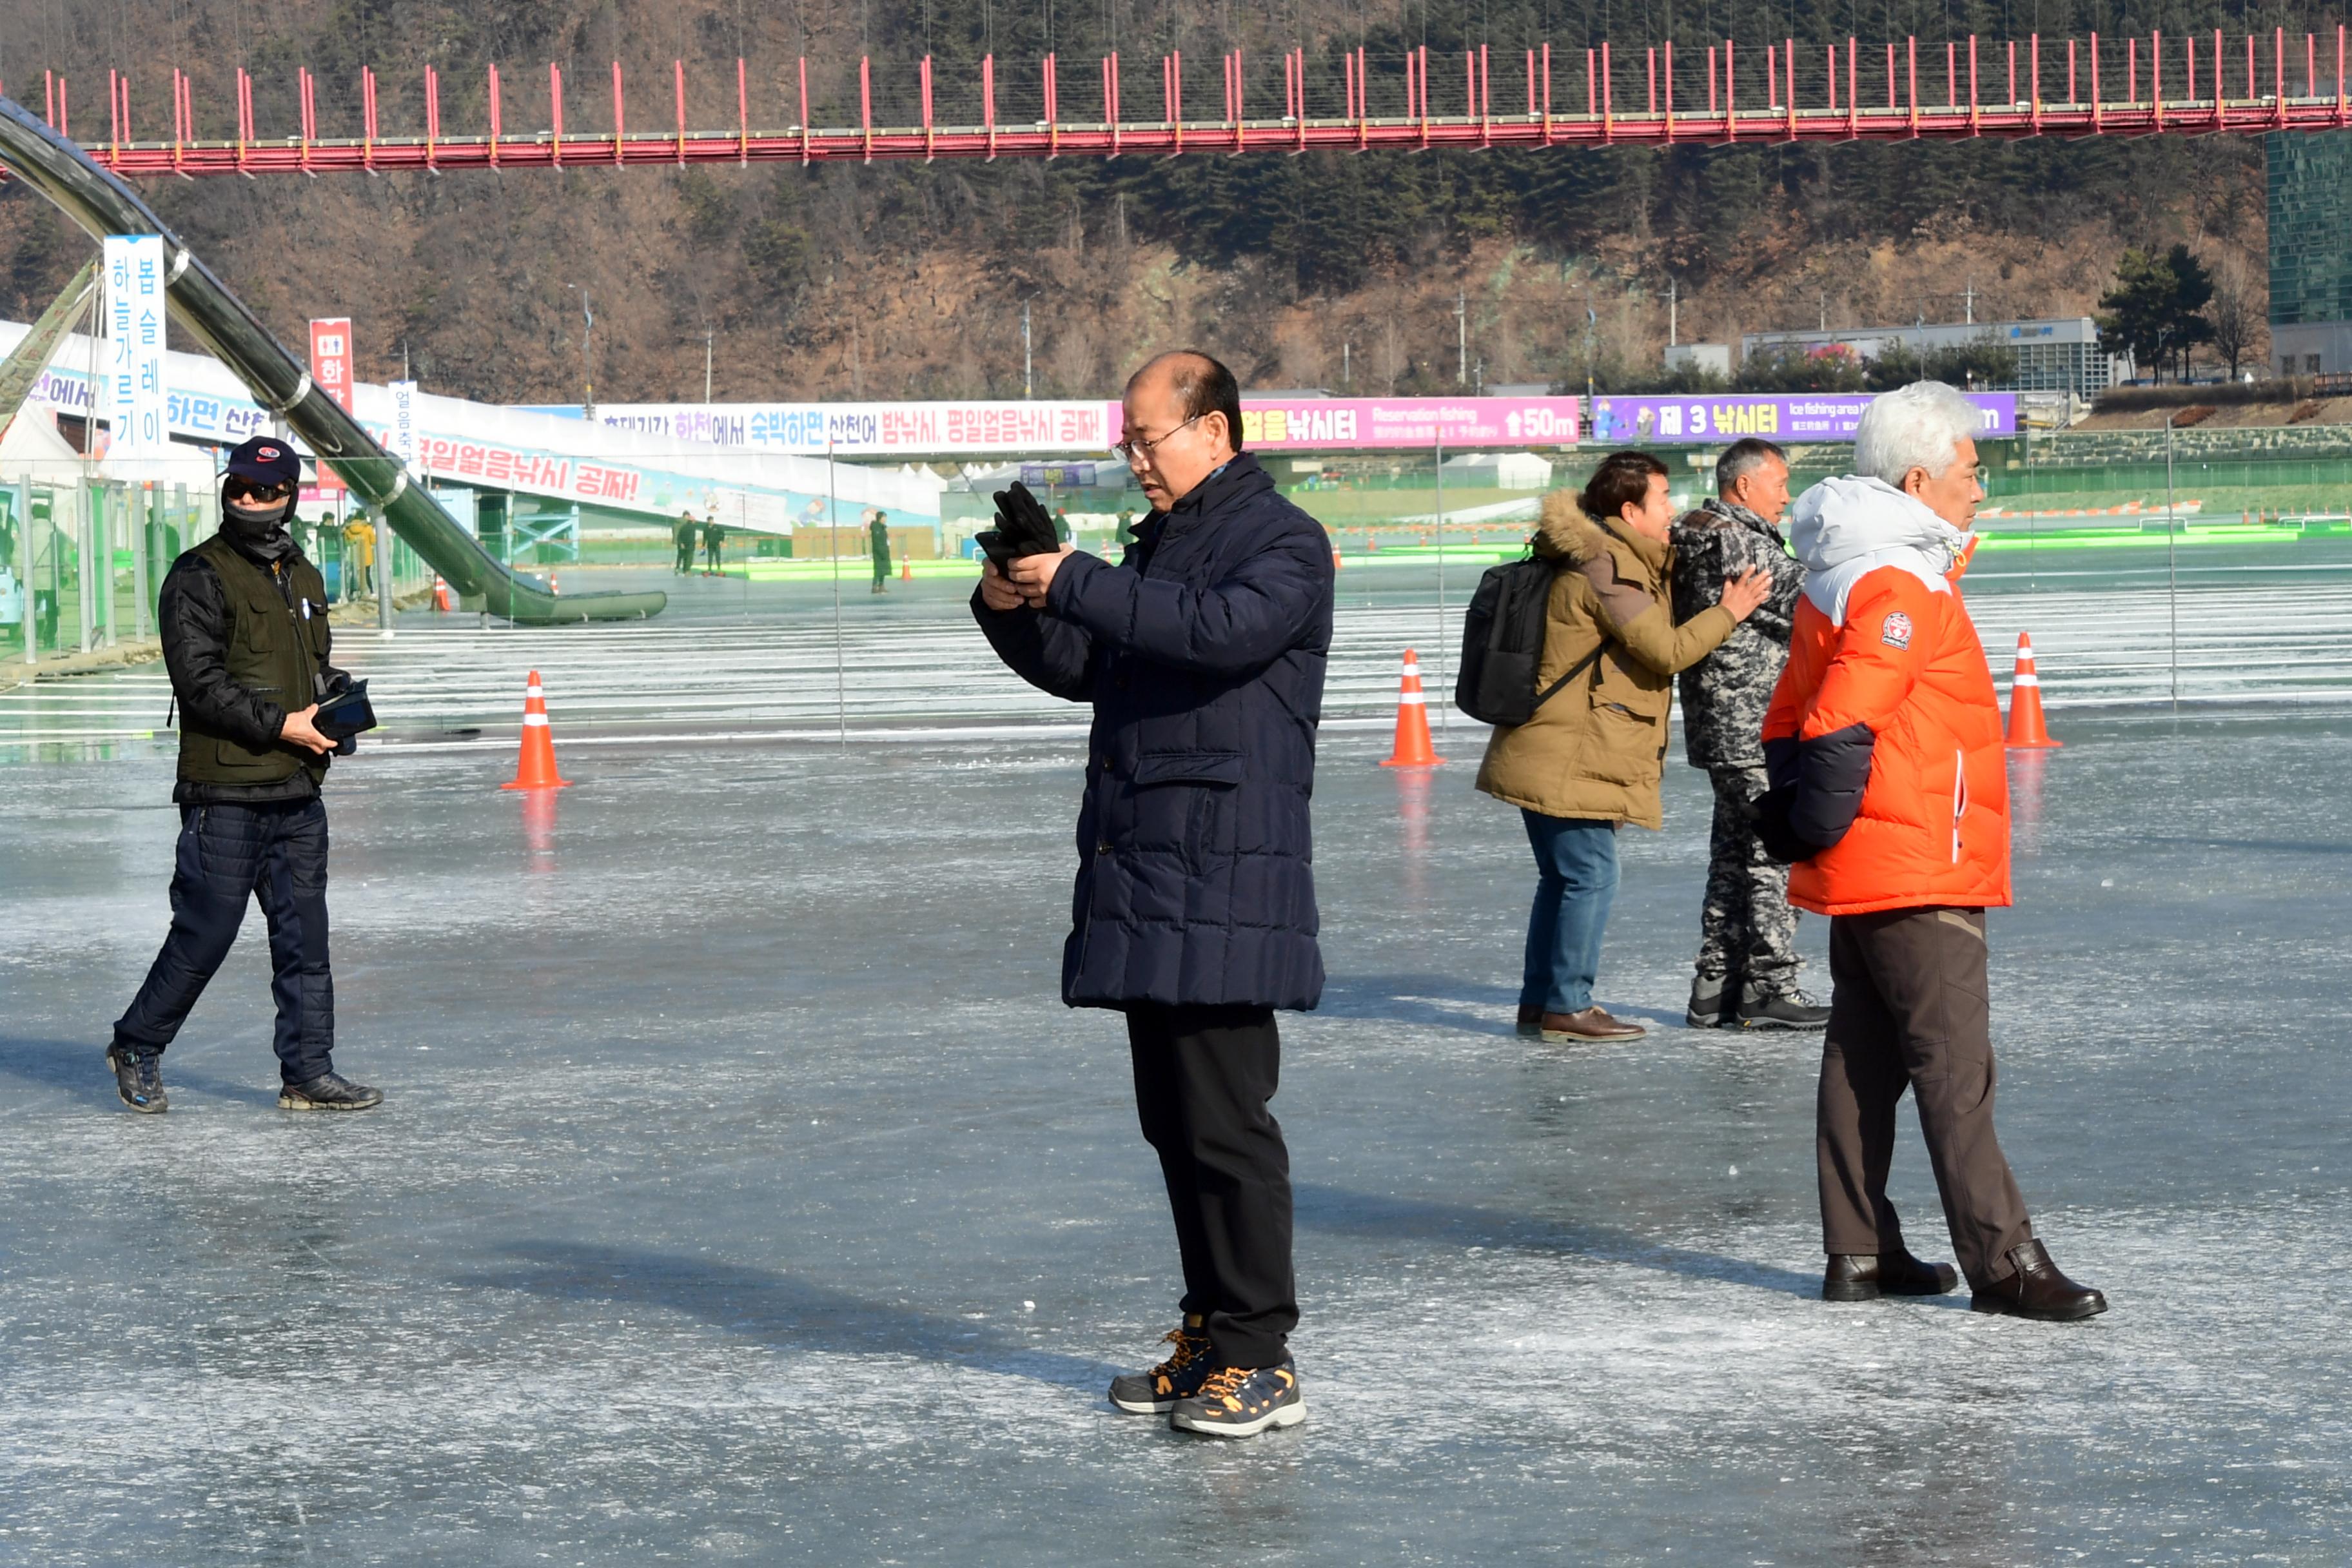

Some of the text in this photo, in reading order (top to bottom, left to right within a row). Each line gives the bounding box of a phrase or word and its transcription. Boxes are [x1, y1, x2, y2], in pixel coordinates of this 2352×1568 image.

[113, 256, 134, 446] 하늘가르기
[138, 259, 160, 445] 봅슬레이
[1372, 407, 1478, 424] Reservation fishing
[1524, 408, 1575, 437] 50m
[1660, 404, 1778, 435] 제 3 낚시터
[1789, 402, 1804, 415] Ice
[1805, 402, 1836, 418] fishing
[1837, 405, 1859, 415] area
[751, 411, 823, 446] 숙박하면
[830, 413, 876, 444] 산천어
[882, 410, 941, 444] 밤낚시,
[948, 409, 1054, 444] 평일얼음낚시
[1060, 409, 1099, 444] 공짜!
[576, 466, 640, 502] 공짜!
